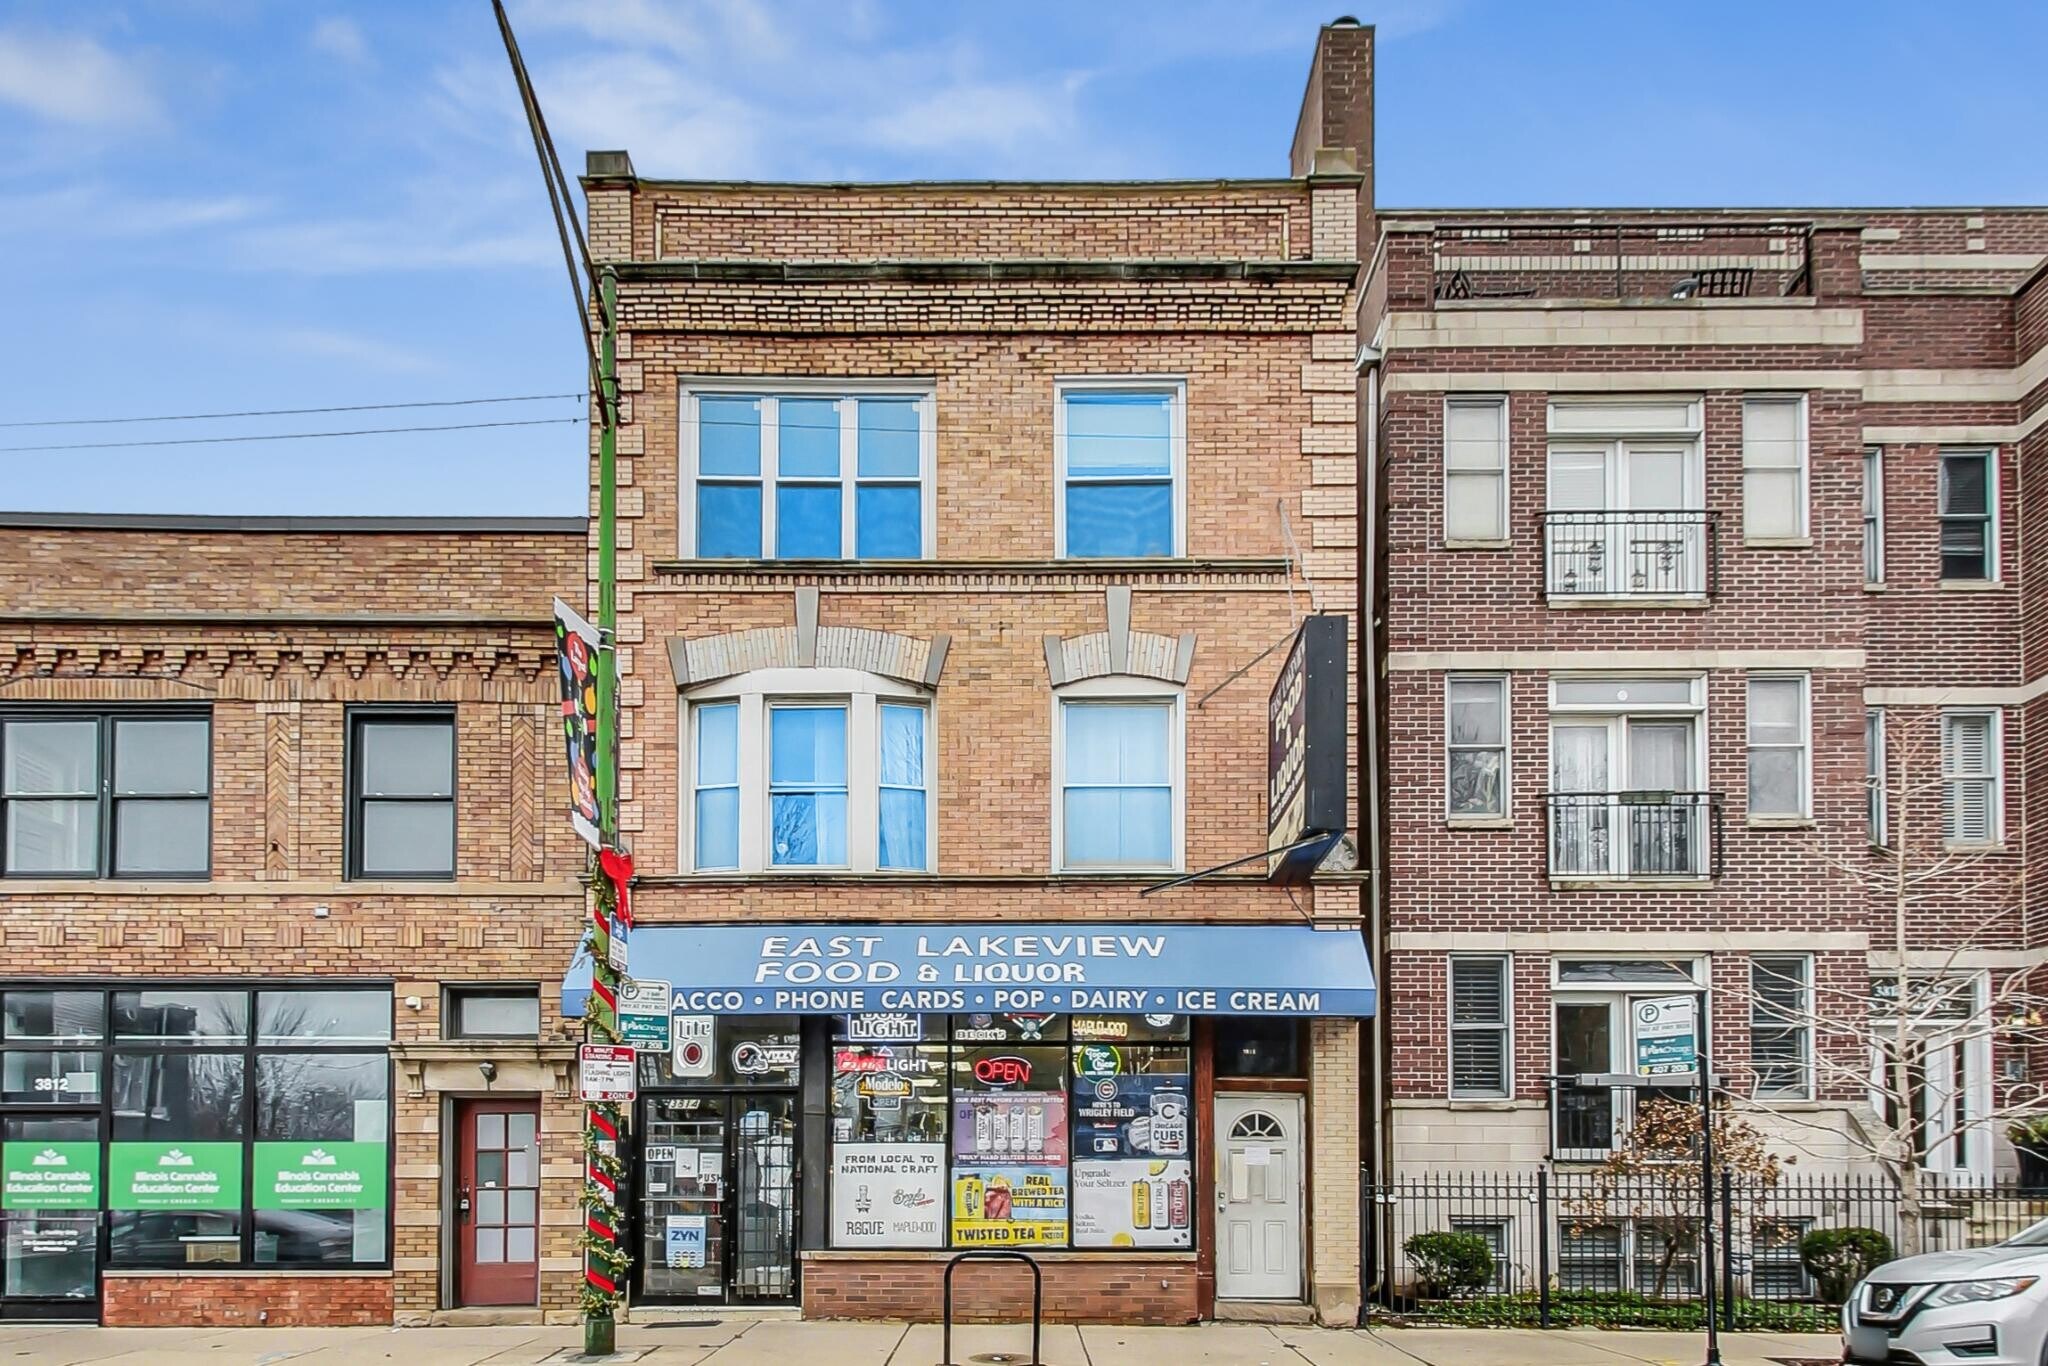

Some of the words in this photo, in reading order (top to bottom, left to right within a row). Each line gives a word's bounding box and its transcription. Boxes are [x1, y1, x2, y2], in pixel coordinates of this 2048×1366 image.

[1276, 672, 1302, 742] FOOD
[1271, 724, 1305, 808] LIQUOR
[761, 936, 884, 957] EAST
[916, 936, 1166, 957] LAKEVIEW
[754, 961, 901, 983] FOOD
[916, 964, 941, 982] &
[954, 963, 1086, 983] LIQUOR
[671, 991, 744, 1011] ACCO
[776, 991, 864, 1010] PHONE
[881, 991, 965, 1010] CARDS
[994, 991, 1044, 1009] POP
[1071, 991, 1148, 1010] DAIRY
[1177, 991, 1217, 1010] ICE
[1230, 991, 1320, 1011] CREAM
[675, 1019, 711, 1040] Lite
[851, 1020, 917, 1038] LIGHT
[955, 1028, 1007, 1040] BECK'S
[763, 1050, 797, 1060] VIZZY
[887, 1059, 928, 1072] LIGHT
[975, 1060, 1031, 1083] OPEN
[34, 1078, 69, 1091] 3812
[865, 1076, 904, 1091] Modelo
[608, 1092, 630, 1100] ZONE
[1079, 1109, 1112, 1117] WRIGLEY
[1113, 1108, 1135, 1117] FIELD
[1154, 1130, 1184, 1140] CUBS
[648, 1148, 674, 1159] OPEN
[845, 1155, 876, 1163] FROM
[881, 1155, 915, 1163] LOCAL
[921, 1155, 935, 1163] TO
[841, 1165, 896, 1174] NATIONAL
[901, 1165, 938, 1174] CRAFT
[1075, 1168, 1111, 1179] Upgrade
[135, 1171, 169, 1181] Illinois
[170, 1171, 217, 1181] Cannabis
[278, 1171, 311, 1181] Illinois
[313, 1171, 360, 1181] Cannabis
[698, 1174, 721, 1182] PUSH
[1026, 1175, 1049, 1186] REAL
[132, 1183, 184, 1193] Education
[185, 1183, 220, 1193] Center
[275, 1183, 326, 1193] Education
[328, 1183, 363, 1193] Center
[1075, 1180, 1094, 1188] Your
[1012, 1187, 1046, 1196] BREWED
[1048, 1187, 1065, 1195] TEA
[1013, 1198, 1034, 1207] WITH
[1044, 1198, 1065, 1207] KICK
[846, 1221, 884, 1235] ROGUE
[671, 1230, 700, 1241] ZYN
[956, 1228, 1009, 1240] TWISTED
[1013, 1228, 1035, 1240] TEA
